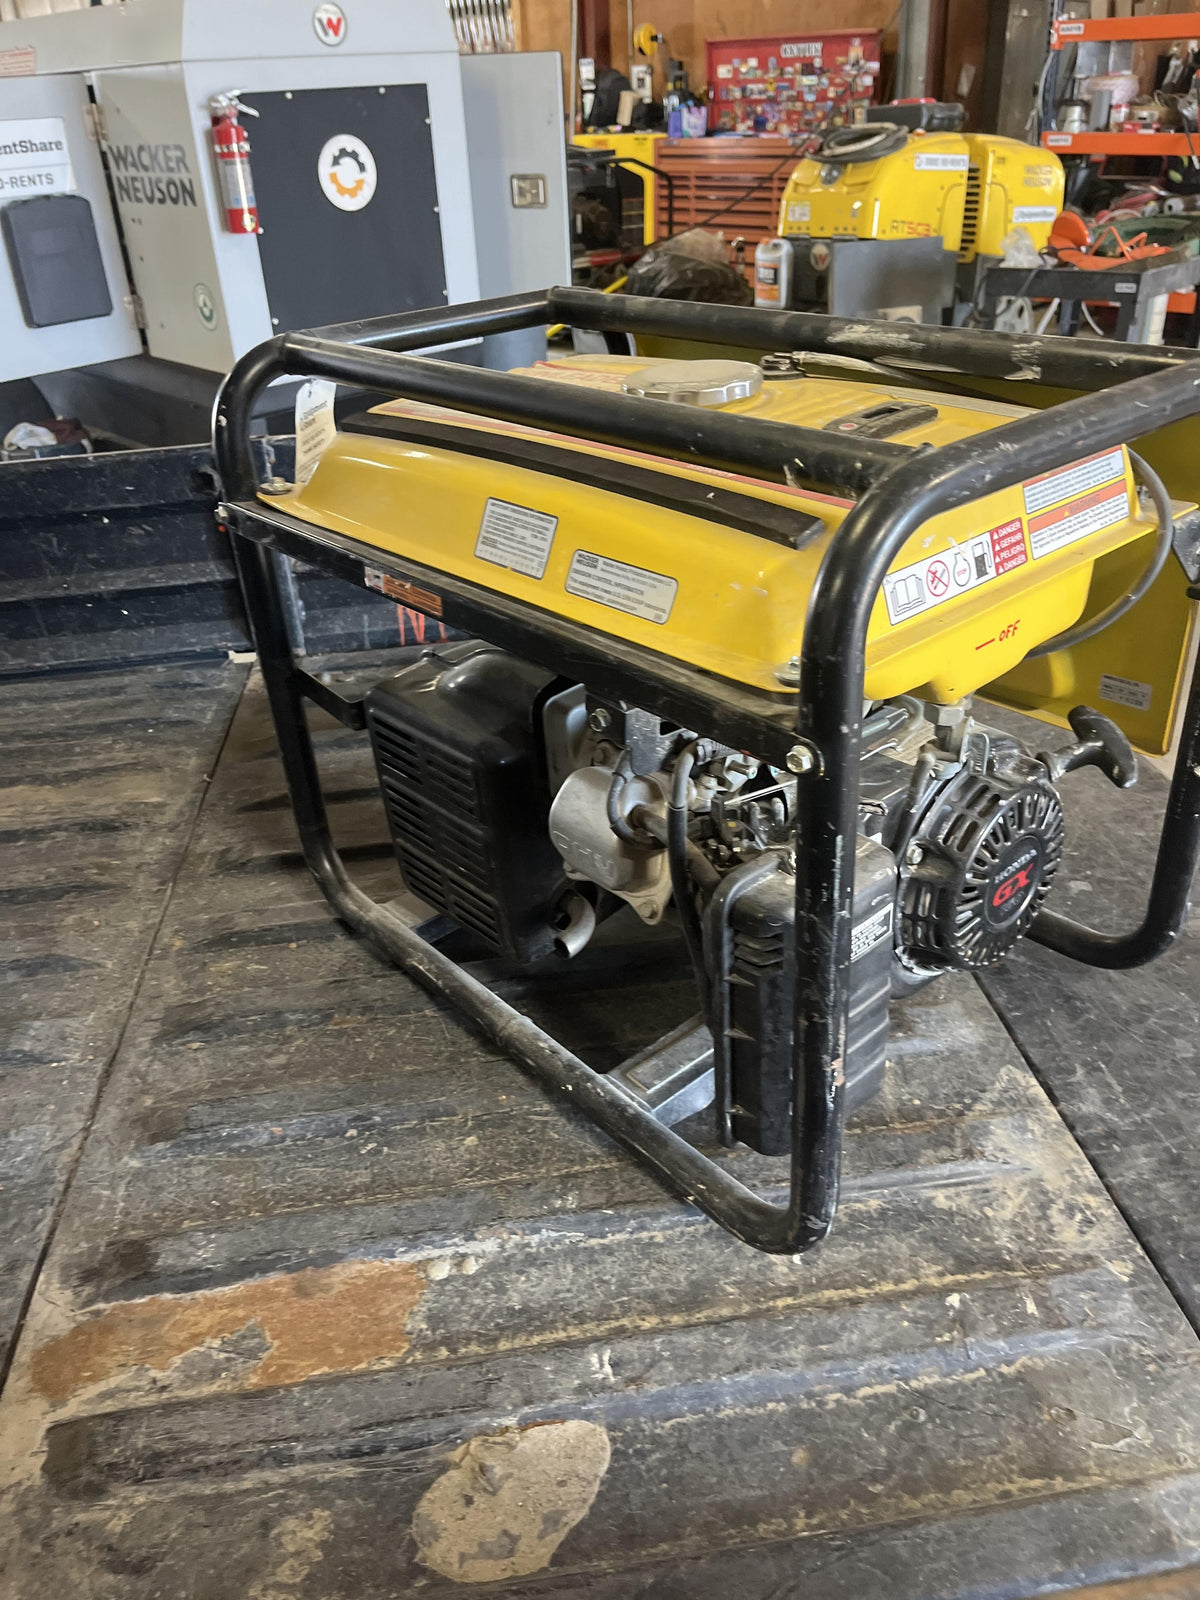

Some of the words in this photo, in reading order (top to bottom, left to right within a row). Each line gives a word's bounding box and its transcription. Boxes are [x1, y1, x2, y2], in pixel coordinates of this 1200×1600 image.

[0, 139, 64, 155] ntShare
[107, 144, 191, 174] WACKER
[116, 175, 198, 207] NEUSON
[998, 521, 1022, 538] DANGER
[1000, 532, 1023, 548] GEFAHR
[1001, 543, 1025, 560] PELIGRO
[1003, 554, 1027, 571] DANGER
[998, 619, 1021, 642] OFF
[994, 849, 1038, 884] HONDA
[992, 863, 1034, 907] GX
